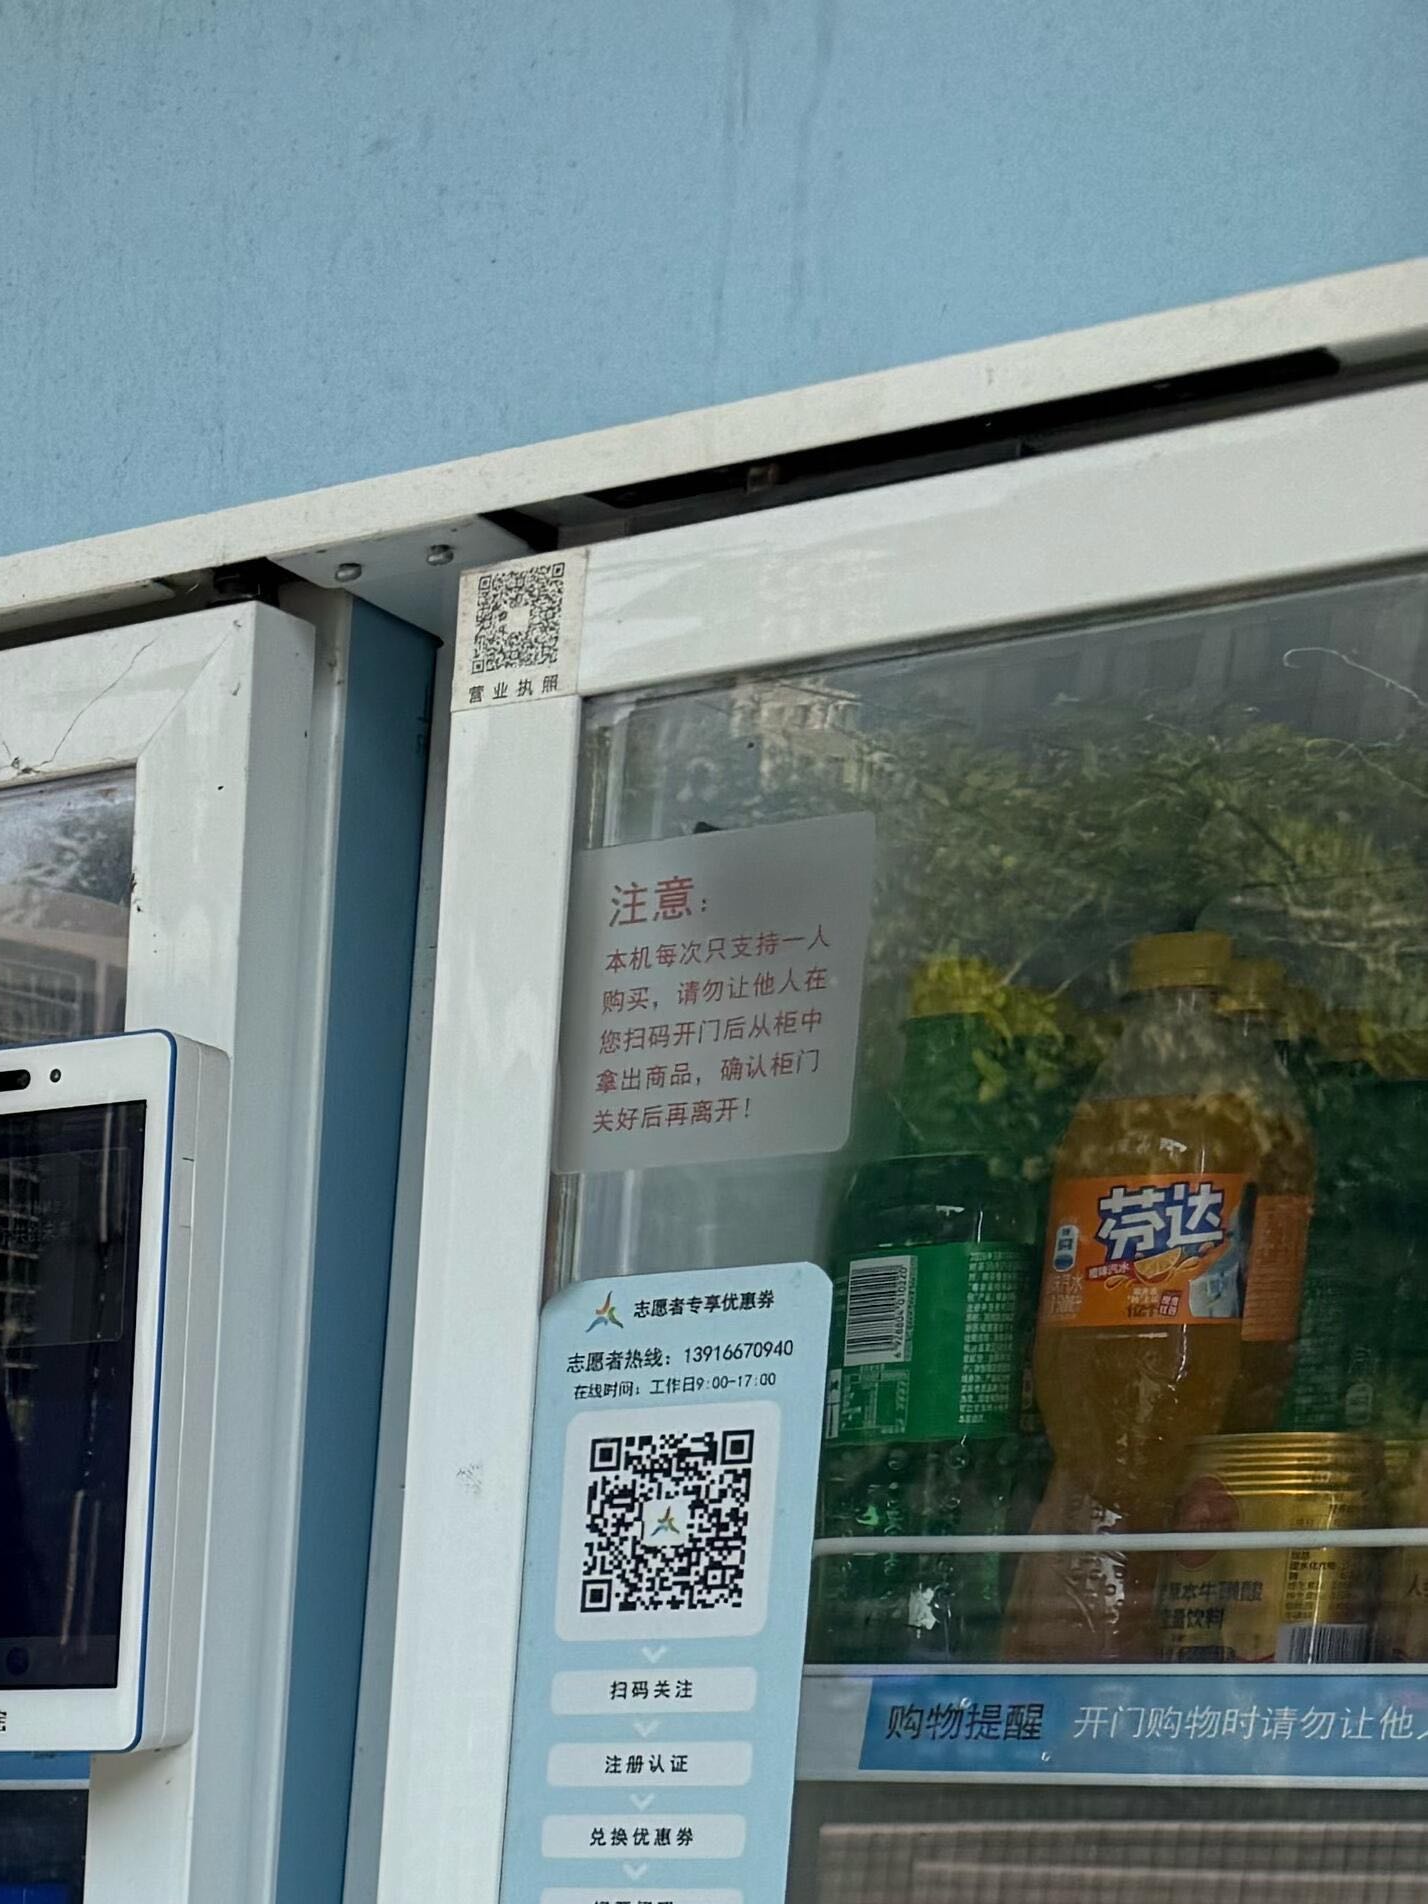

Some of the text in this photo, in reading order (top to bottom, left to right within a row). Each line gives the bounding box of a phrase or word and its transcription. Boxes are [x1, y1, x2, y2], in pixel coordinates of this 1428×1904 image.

[469, 674, 559, 702] 营业执照
[604, 923, 831, 973] 本机每次只支持一人
[601, 966, 829, 1014] 购买，请勿让他人在
[598, 1009, 823, 1056] 您扫码开门后从柜中
[594, 1048, 820, 1095] 拿出商品，确认柜门
[1098, 1183, 1225, 1260] 芬达
[609, 1679, 694, 1700] 扫码关注
[887, 1702, 1044, 1741] 购物提醒
[604, 1753, 689, 1774] 注册认证
